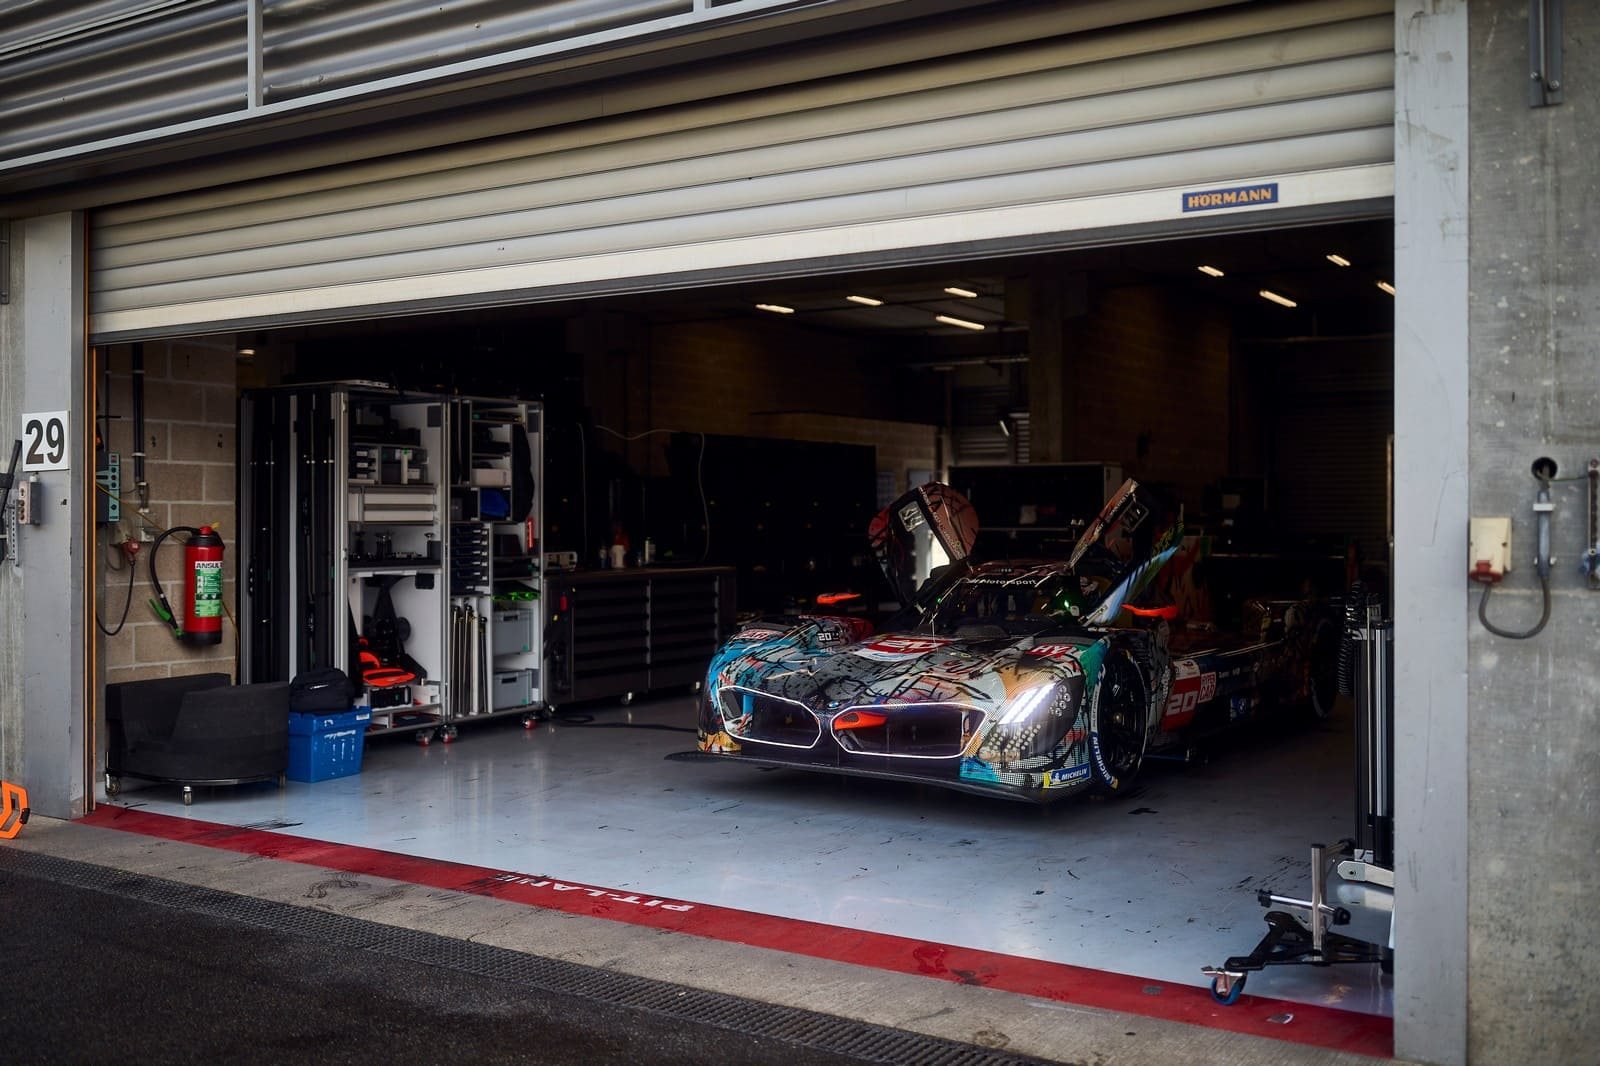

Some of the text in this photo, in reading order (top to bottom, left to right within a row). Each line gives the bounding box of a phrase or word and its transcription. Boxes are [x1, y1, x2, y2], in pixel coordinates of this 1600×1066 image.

[26, 418, 65, 464] 29
[818, 632, 833, 641] 20
[1166, 690, 1199, 716] 20
[1092, 736, 1113, 780] MICHELIN
[1061, 767, 1088, 781] MICHELIN
